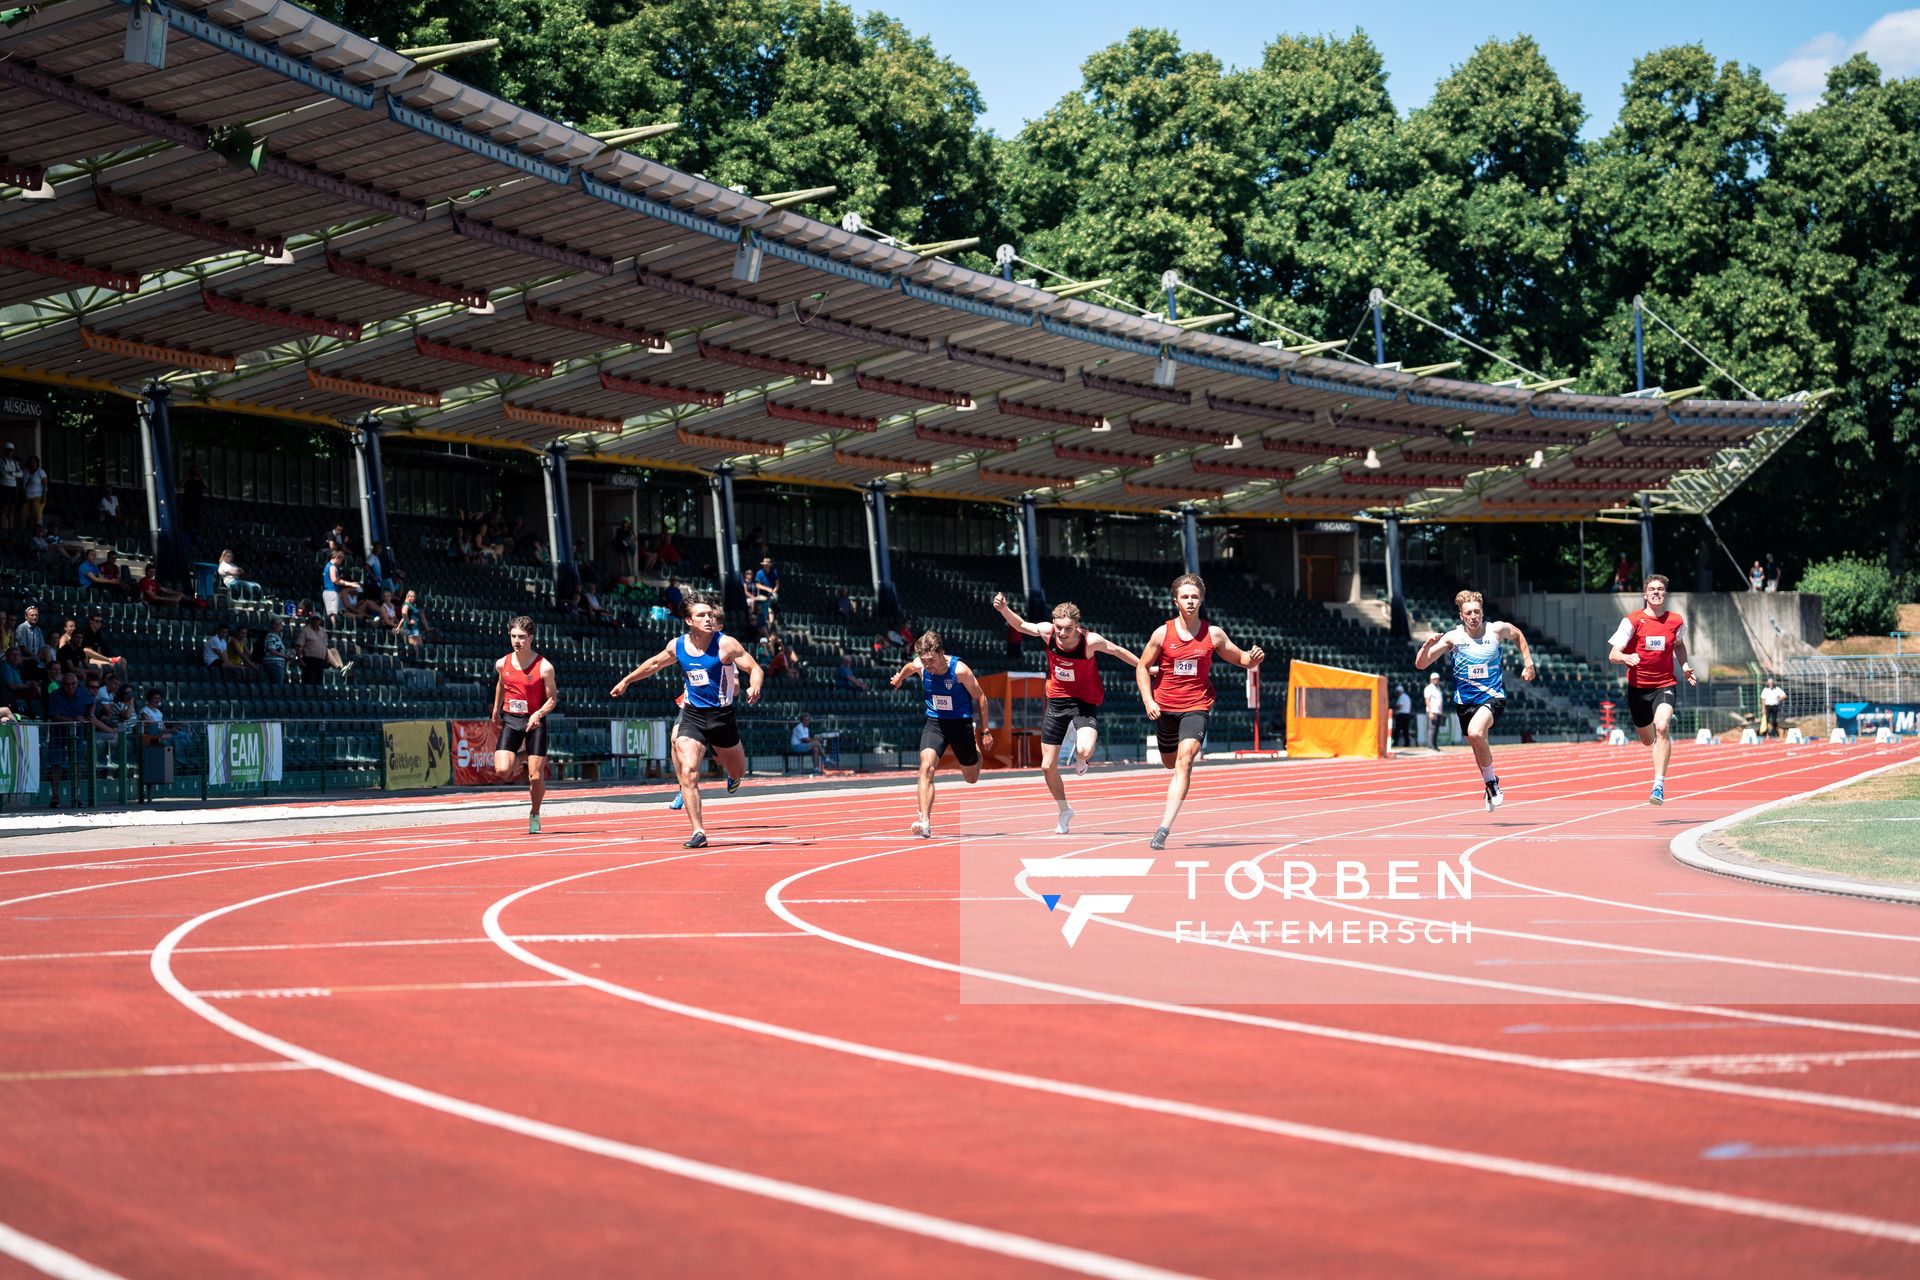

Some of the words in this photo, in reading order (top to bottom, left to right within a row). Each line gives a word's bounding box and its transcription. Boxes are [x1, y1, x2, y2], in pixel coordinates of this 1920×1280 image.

[4, 400, 42, 416] AUSGANG
[230, 733, 259, 766] EAM
[627, 728, 648, 754] EAM
[469, 747, 496, 772] Sparka
